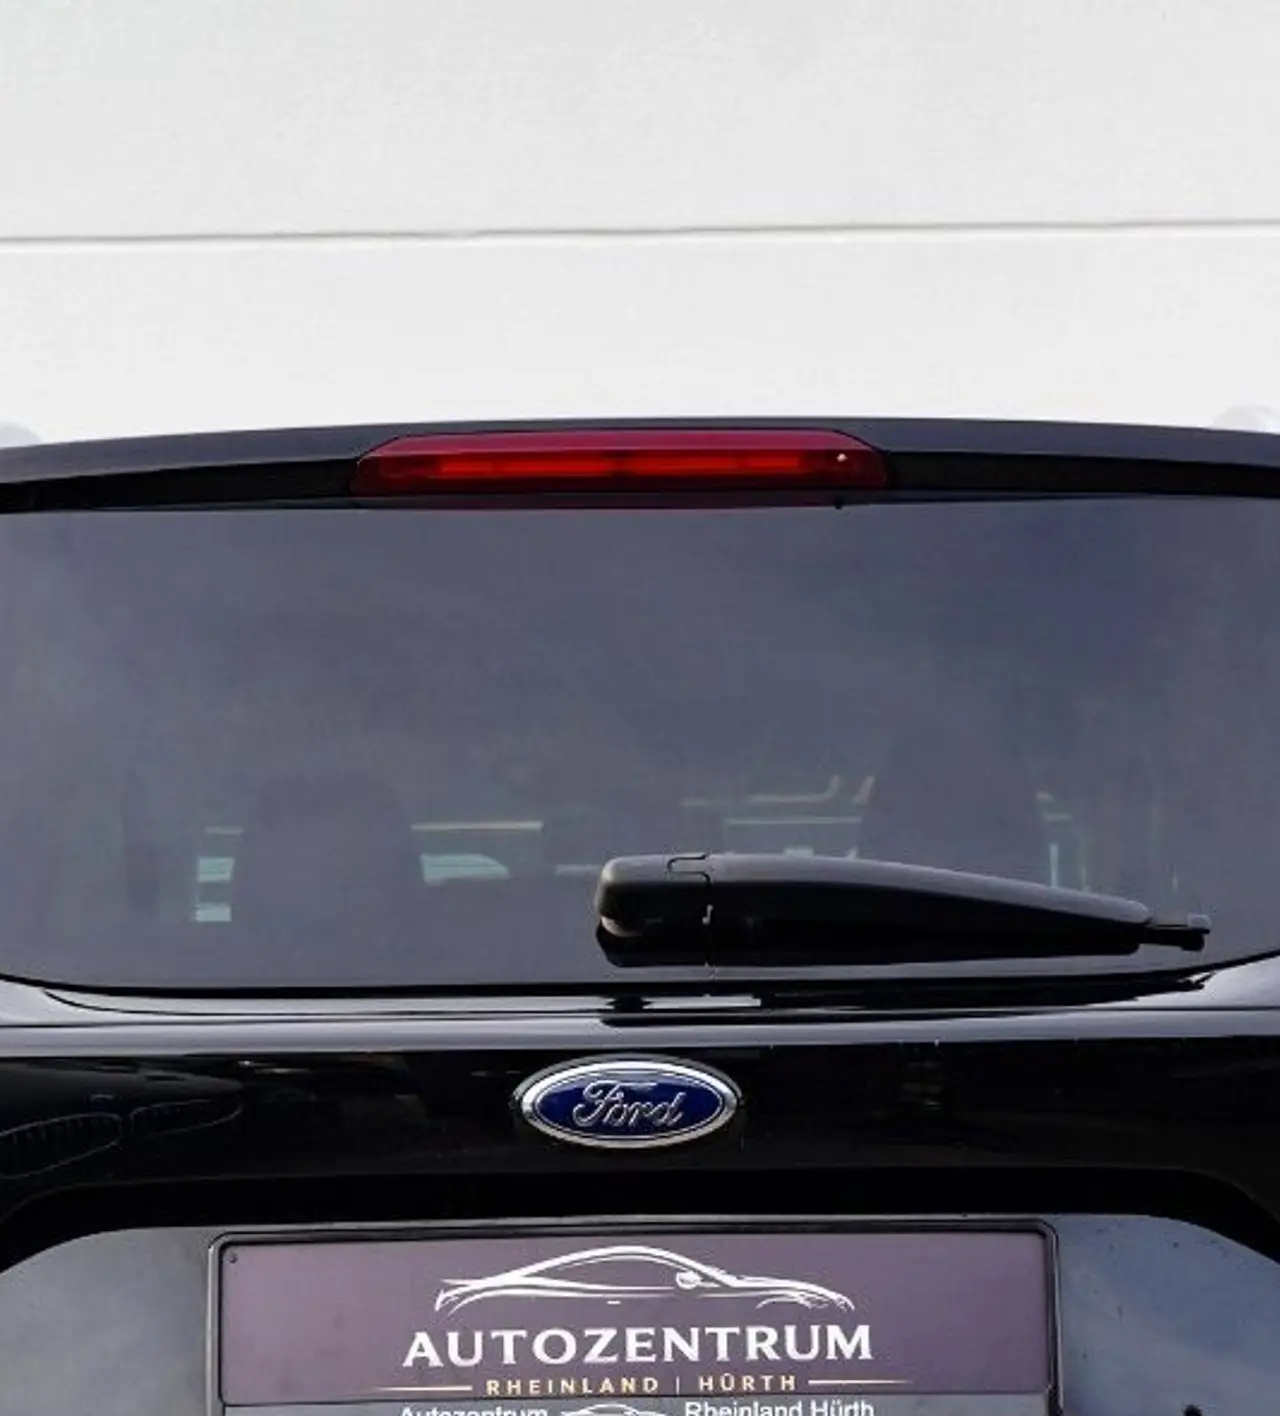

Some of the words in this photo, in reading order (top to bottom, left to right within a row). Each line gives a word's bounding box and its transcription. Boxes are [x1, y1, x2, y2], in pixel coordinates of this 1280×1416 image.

[572, 1079, 687, 1128] Ford
[402, 1325, 873, 1368] AUTOZENTRUM
[486, 1376, 659, 1396] RHEINLAND
[698, 1373, 797, 1392] HÜRTH
